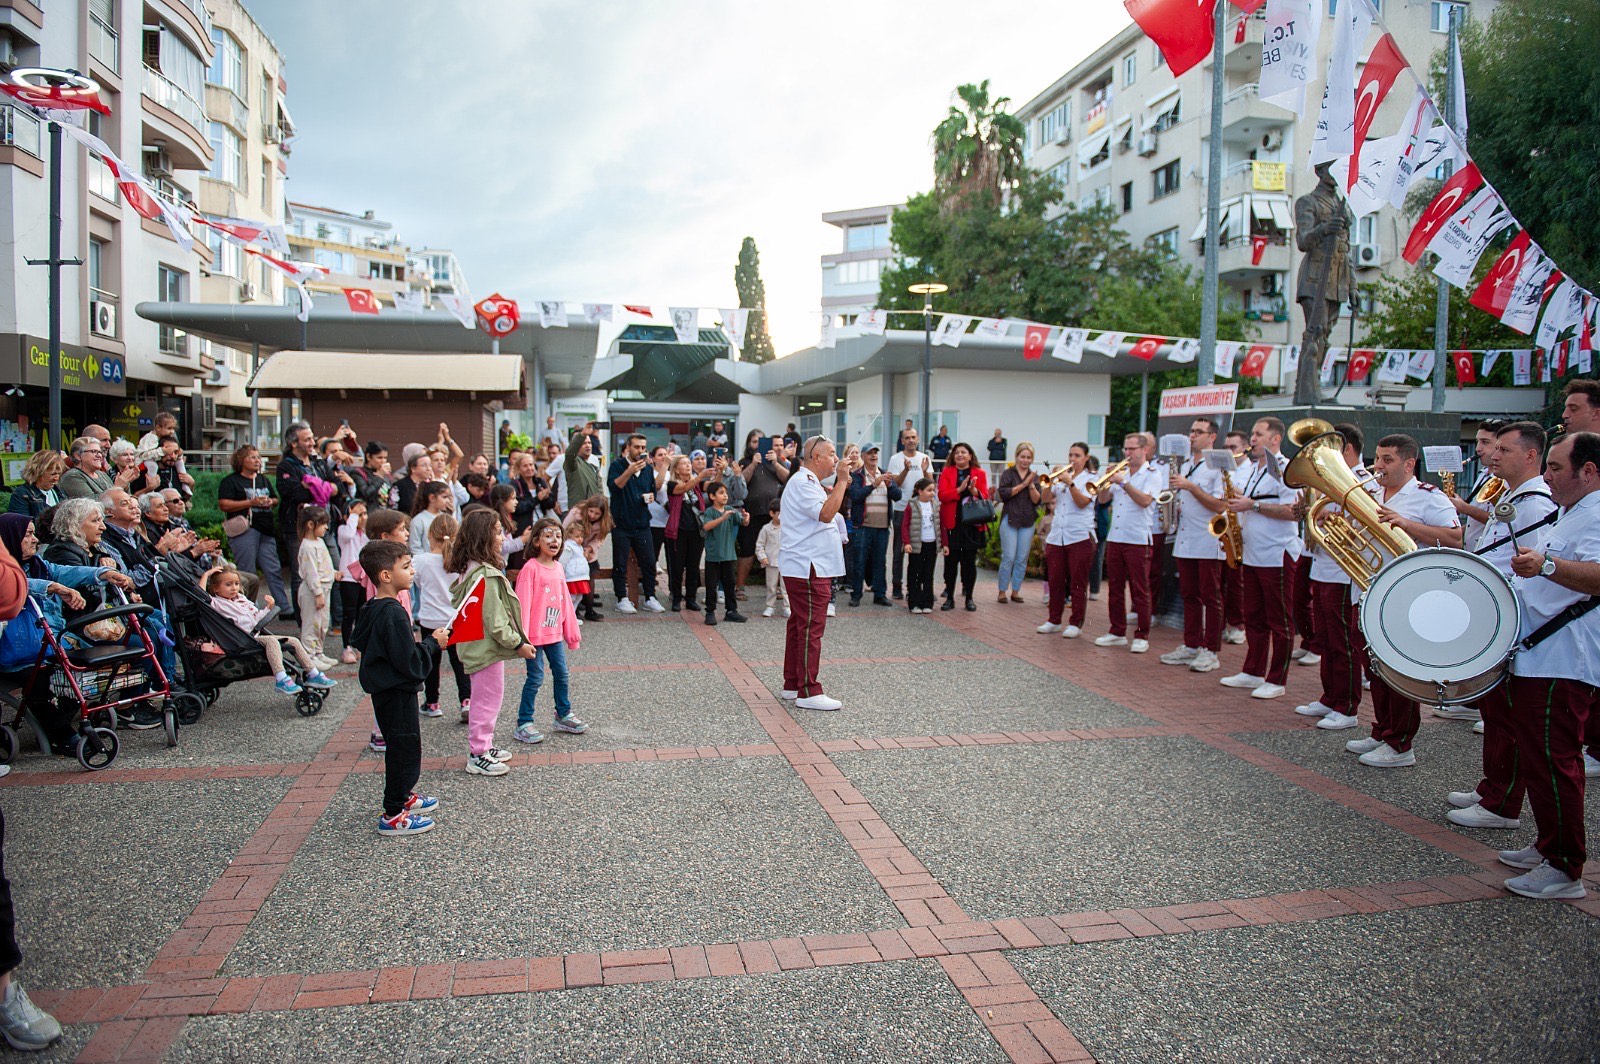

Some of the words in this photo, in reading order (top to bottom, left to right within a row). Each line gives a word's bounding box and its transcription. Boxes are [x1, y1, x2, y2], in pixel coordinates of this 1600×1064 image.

[30, 345, 81, 372] Carfour
[63, 373, 81, 387] mini
[1162, 393, 1188, 413] YAŞASIN
[1189, 388, 1235, 408] CUMHURİYET
